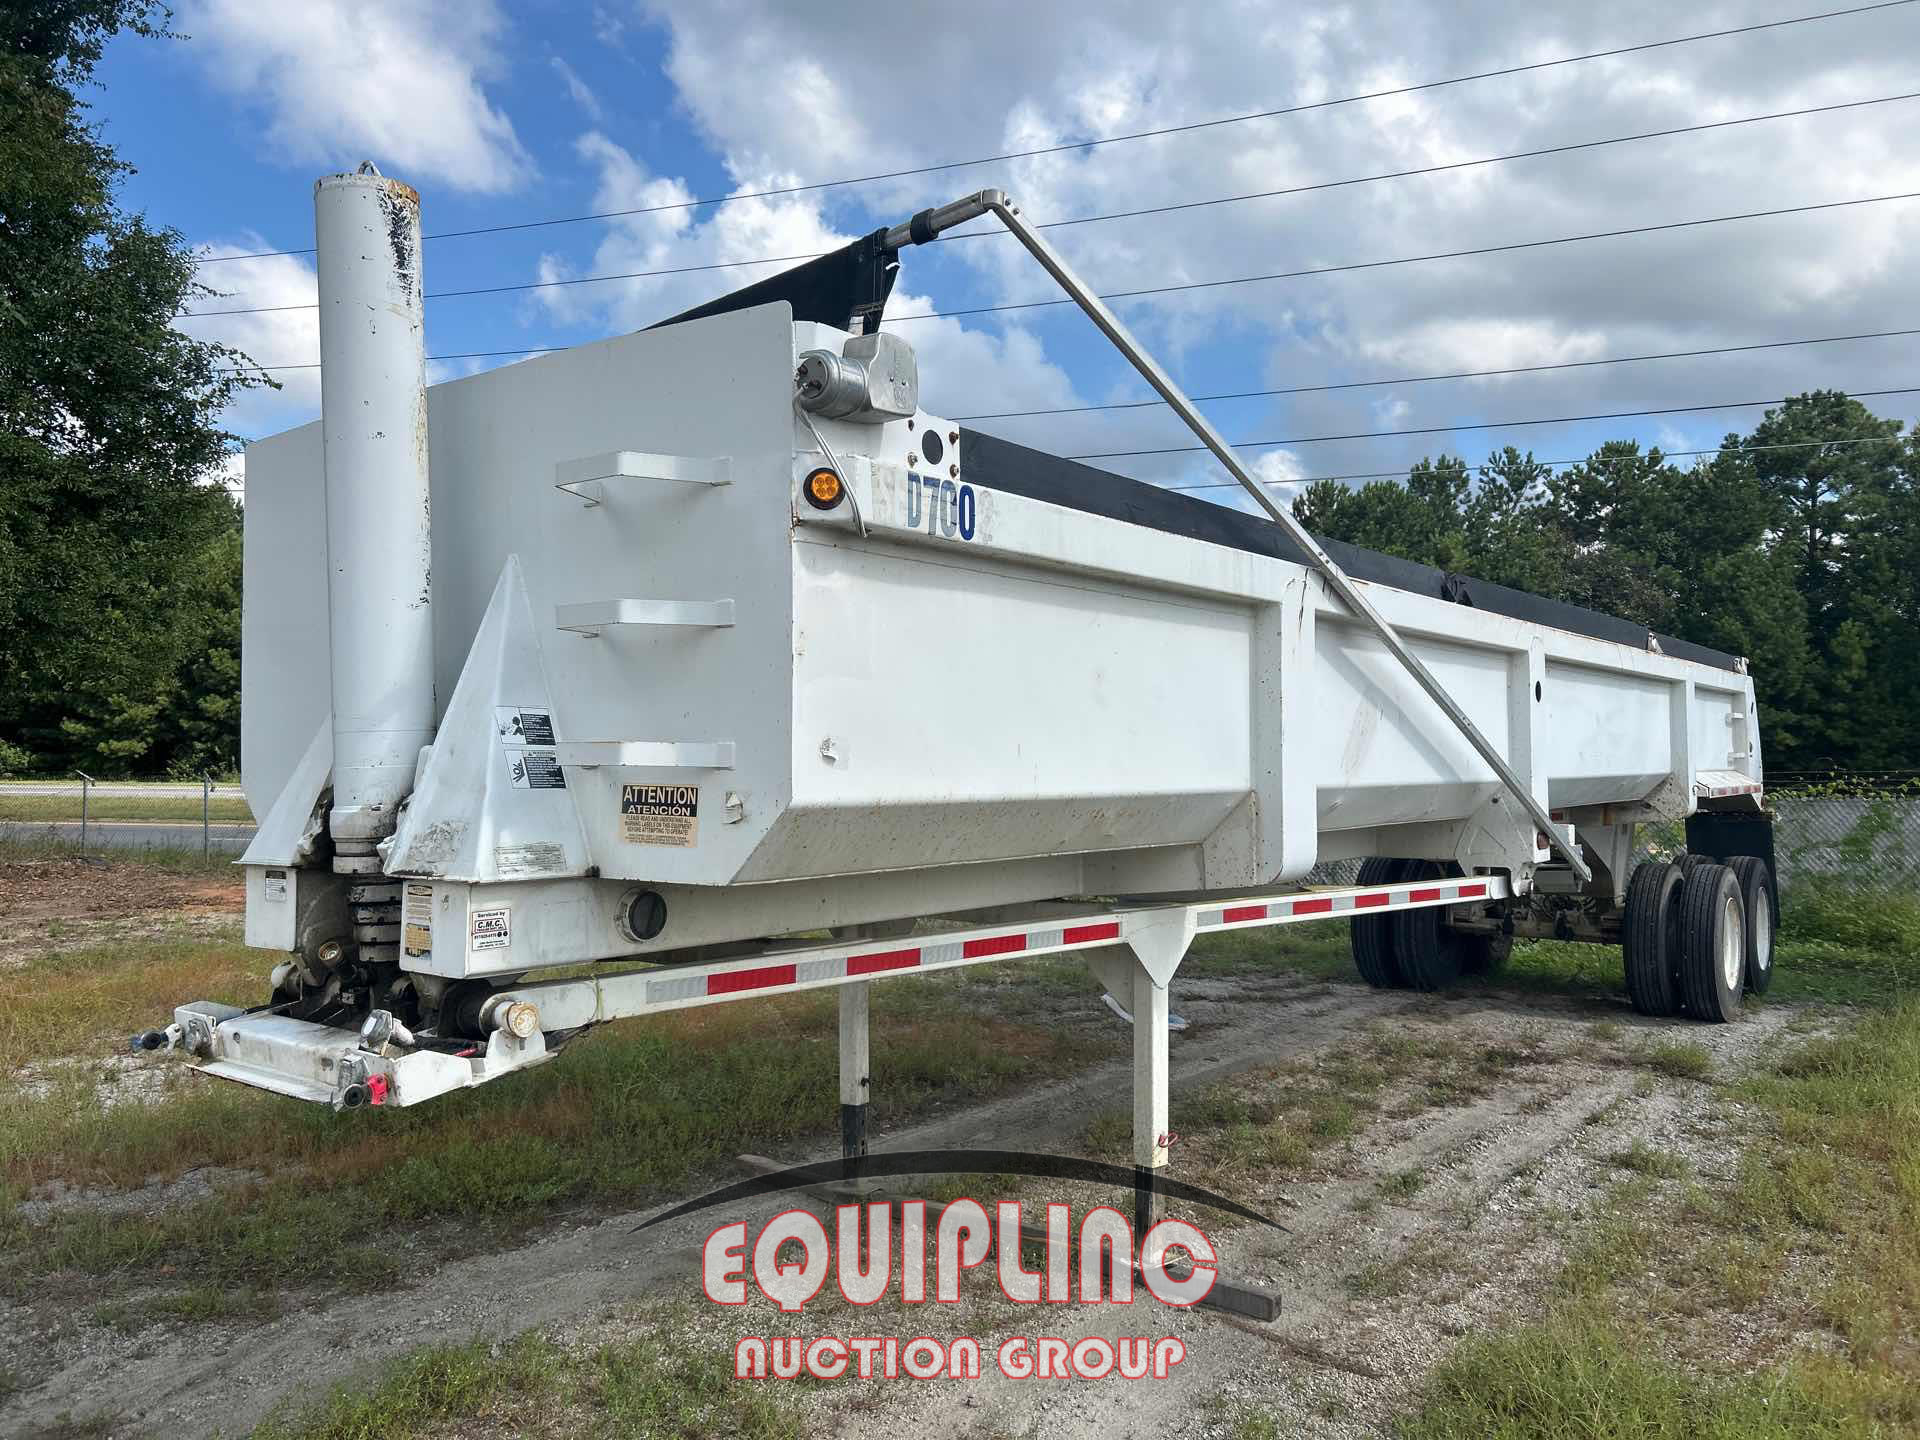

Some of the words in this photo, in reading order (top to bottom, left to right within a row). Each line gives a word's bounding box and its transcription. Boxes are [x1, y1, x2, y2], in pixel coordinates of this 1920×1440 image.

[624, 786, 696, 804] ATTENTION
[628, 804, 690, 816] ATENCIÓN
[478, 919, 503, 929] C.M.C.
